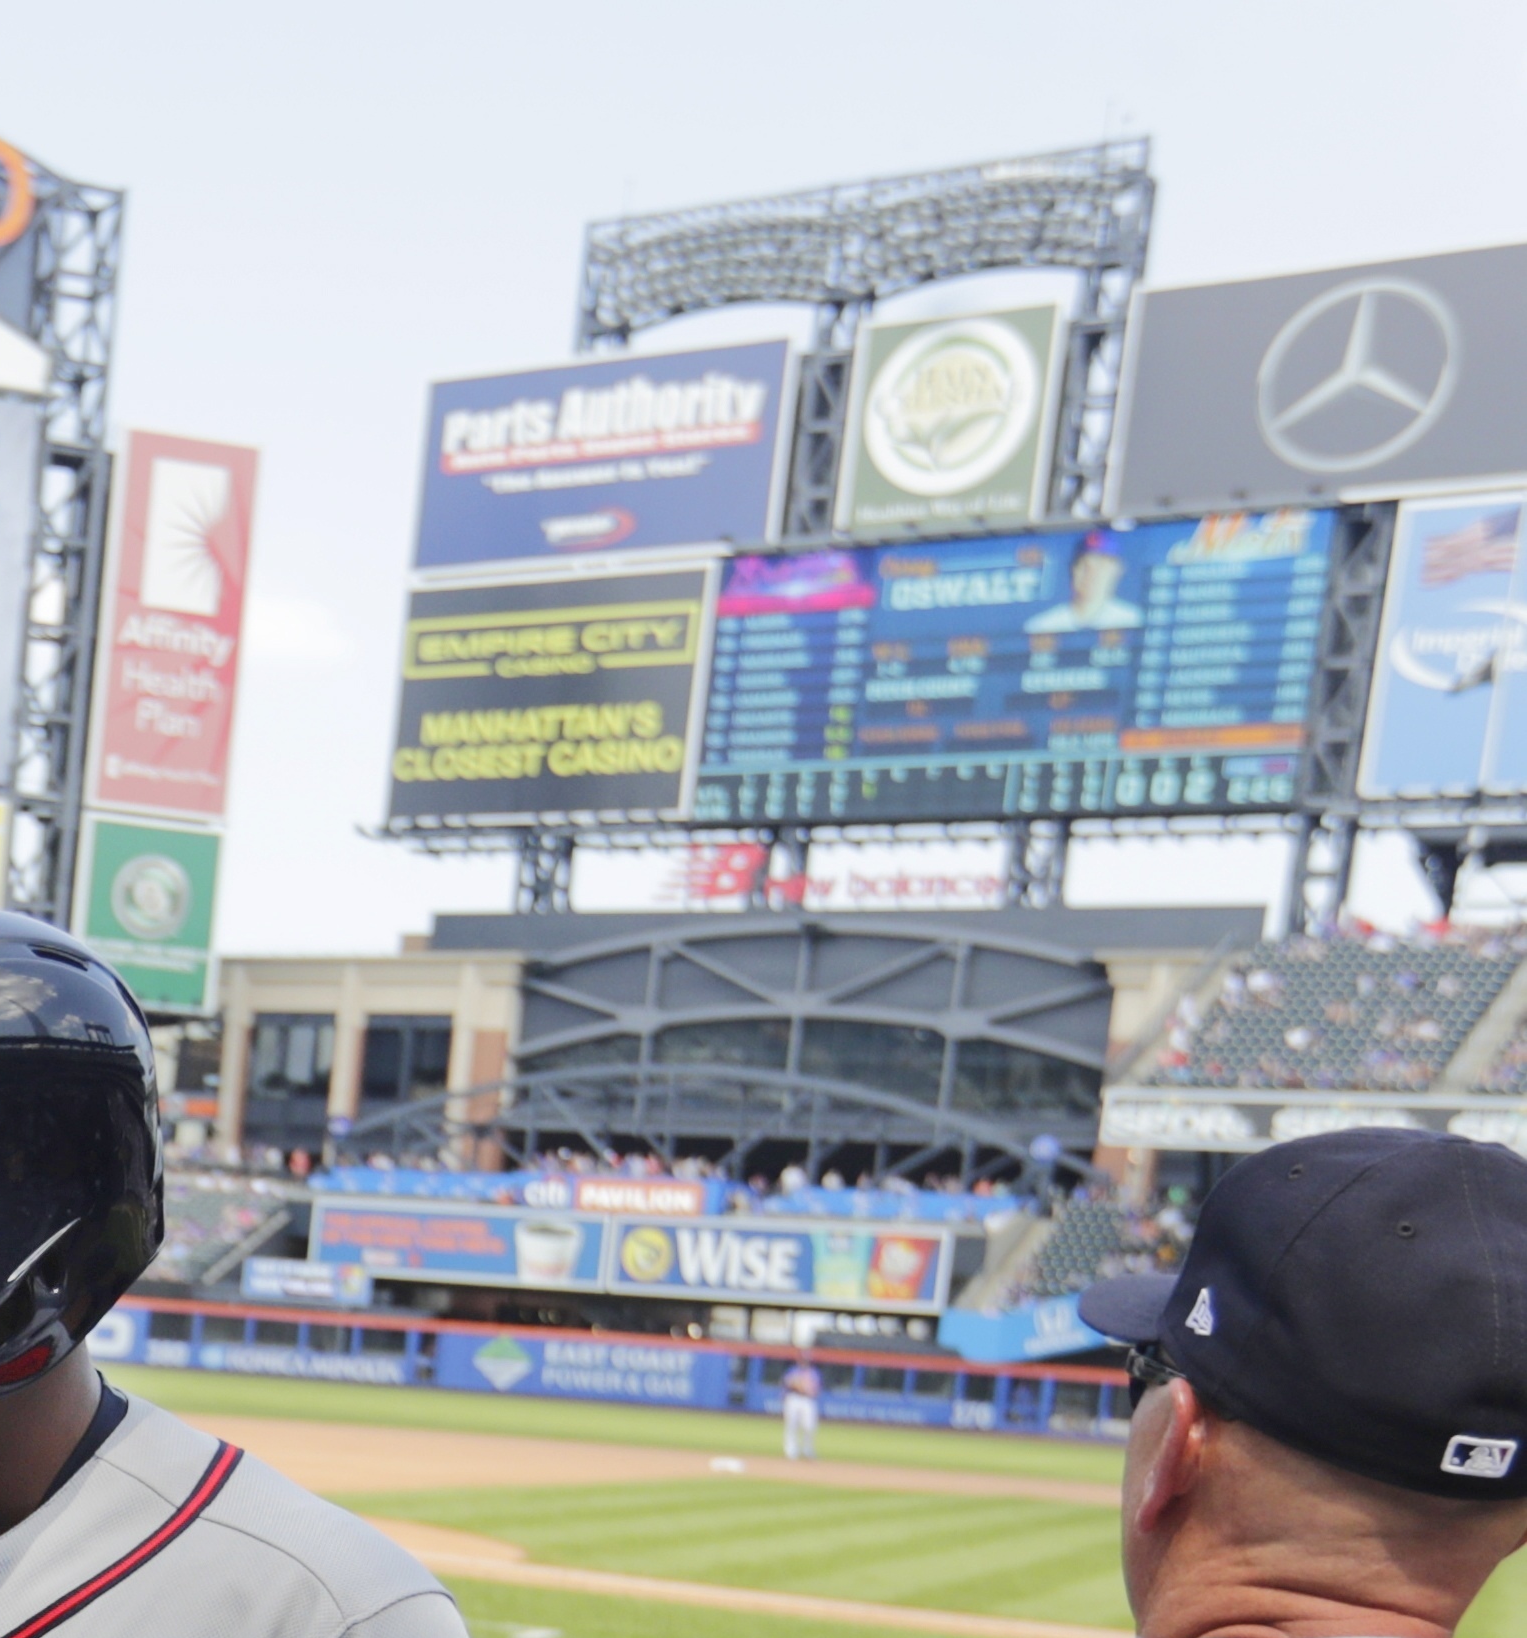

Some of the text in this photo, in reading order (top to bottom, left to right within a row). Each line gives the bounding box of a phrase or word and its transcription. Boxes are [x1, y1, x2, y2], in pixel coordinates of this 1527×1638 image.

[442, 371, 767, 456] Parts Authority
[891, 567, 1041, 610] OSWALT
[116, 613, 235, 668] Affinity
[417, 617, 683, 662] EMPIRE CITY
[121, 656, 224, 704] Health
[135, 697, 202, 740] Plan
[420, 700, 663, 746] MANHATTAN'S
[392, 736, 685, 782] CLOSEST CASINO
[580, 1183, 694, 1215] PAVILION
[674, 1227, 803, 1293] WISE
[545, 1342, 693, 1374] EAST COAST
[543, 1367, 626, 1394] POWER
[648, 1373, 693, 1399] GAS
